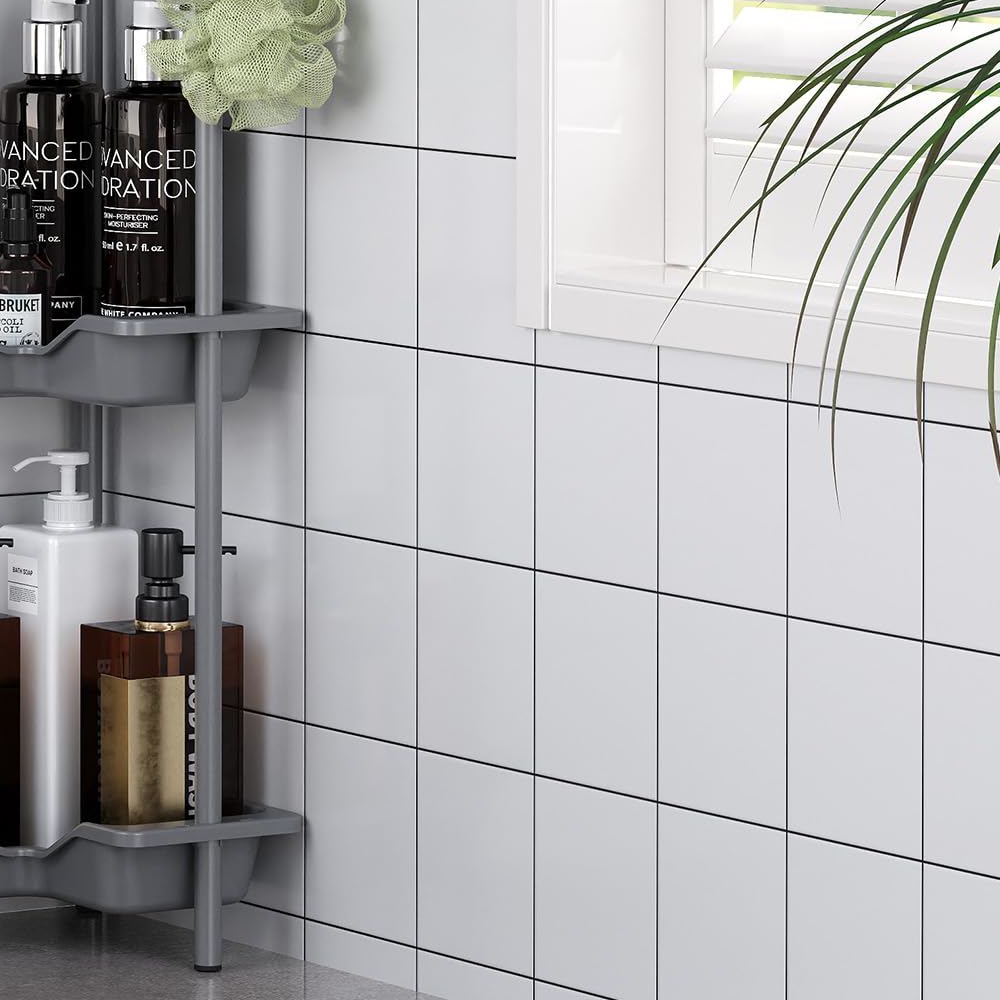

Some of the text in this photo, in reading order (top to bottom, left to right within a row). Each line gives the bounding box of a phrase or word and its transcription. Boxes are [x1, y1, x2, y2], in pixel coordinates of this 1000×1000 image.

[101, 146, 196, 170] VANCED
[125, 243, 138, 251] 1.7
[0, 298, 40, 312] BRUKET
[3, 325, 23, 333] OIL
